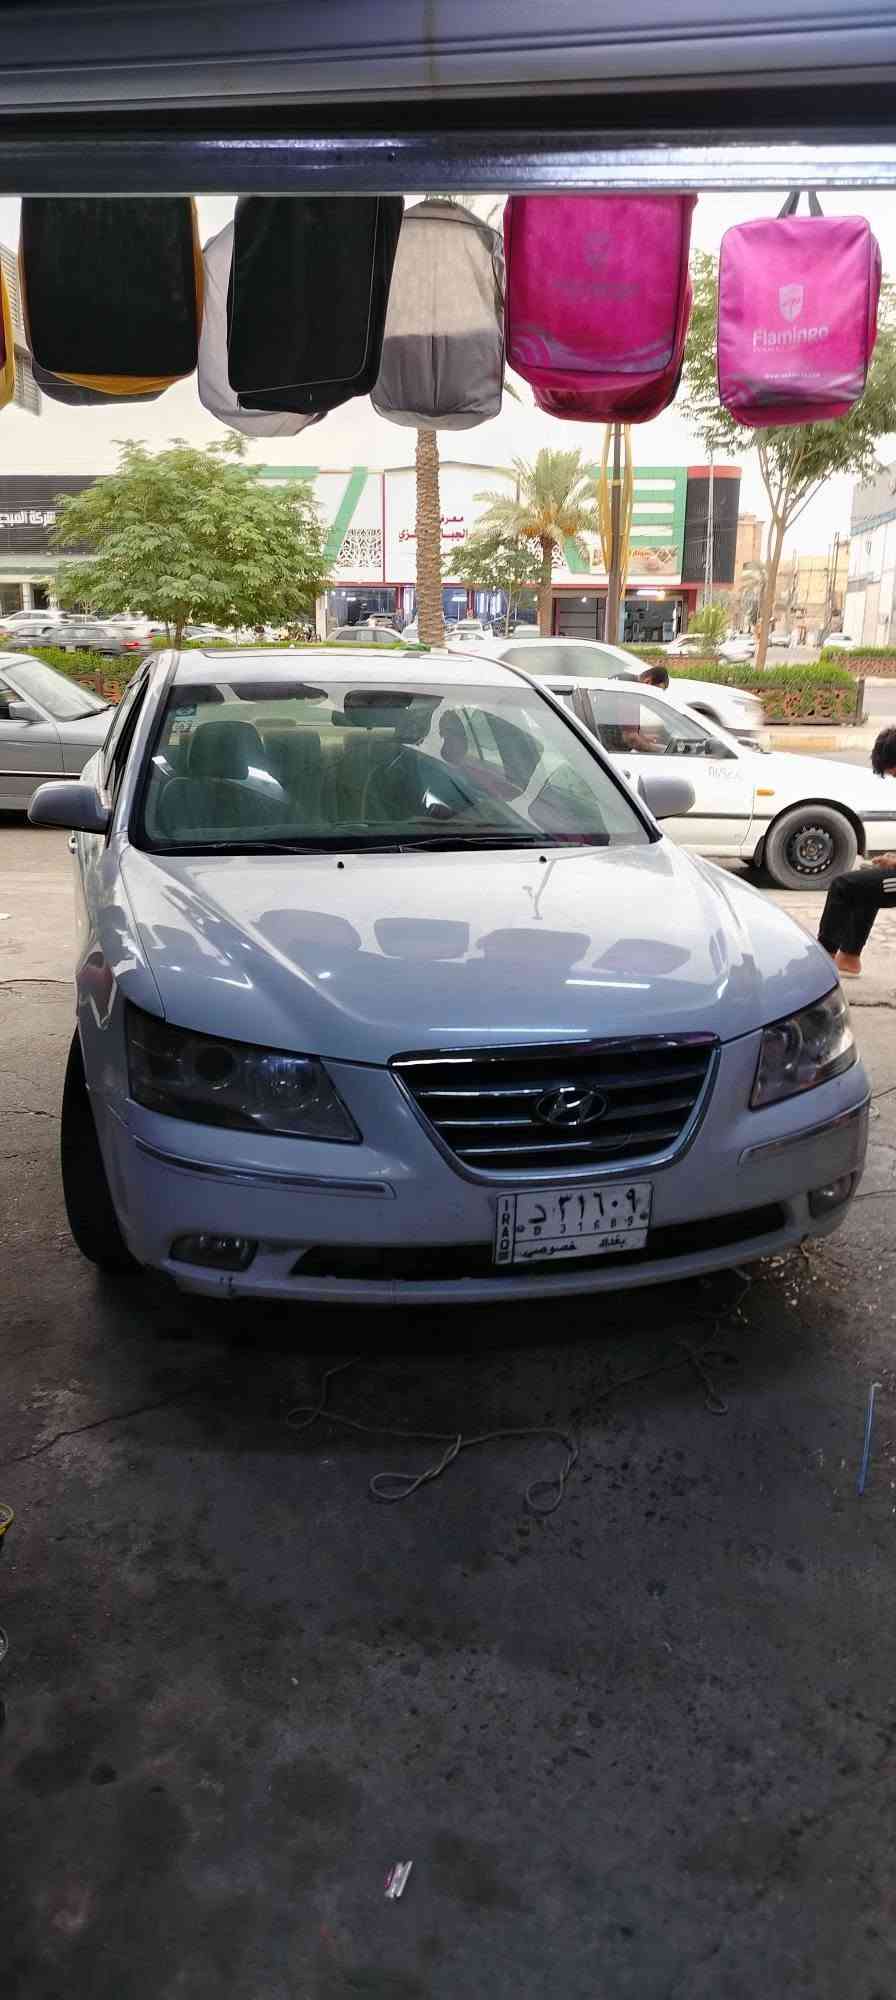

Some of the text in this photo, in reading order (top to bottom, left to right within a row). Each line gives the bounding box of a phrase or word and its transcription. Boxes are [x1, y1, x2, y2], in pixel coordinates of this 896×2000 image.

[753, 325, 829, 346] Flamingo
[500, 1199, 511, 1250] IRAQ
[519, 1235, 627, 1258] بغداد خصوصي
